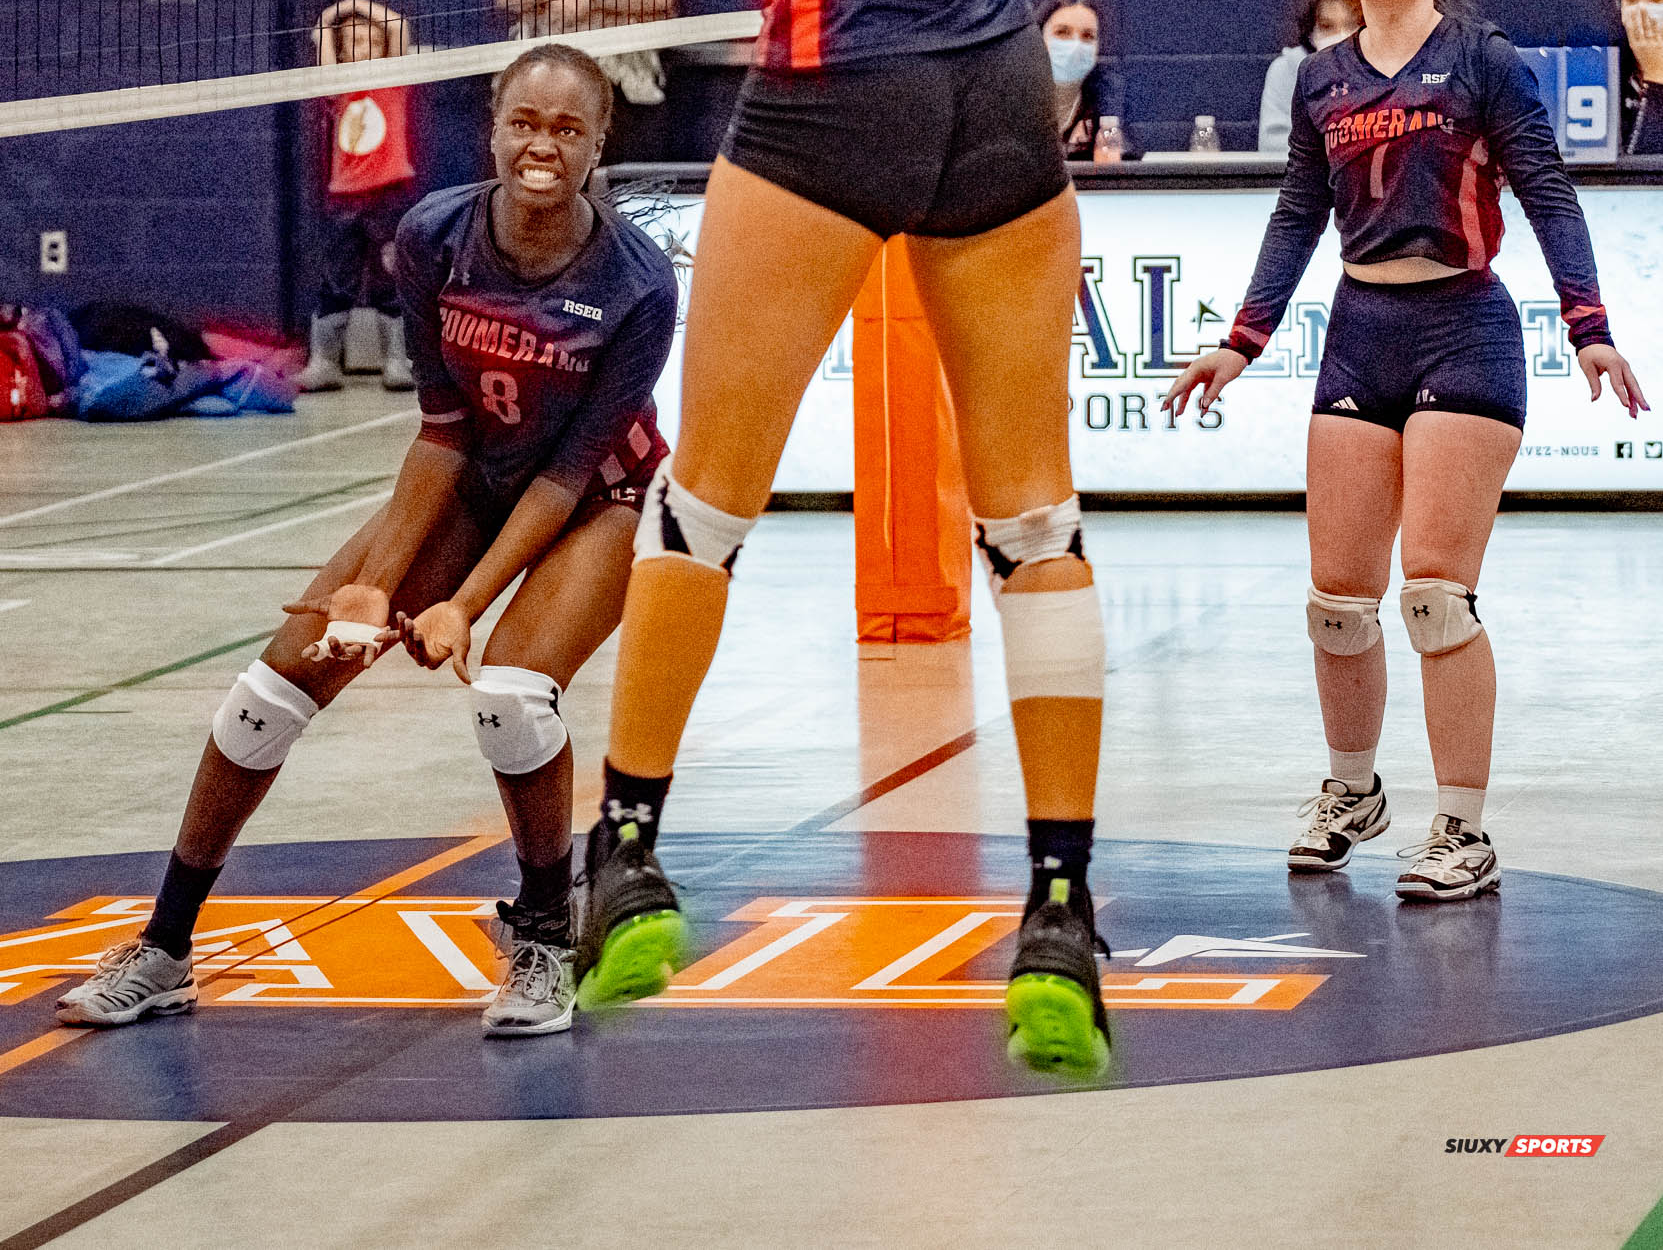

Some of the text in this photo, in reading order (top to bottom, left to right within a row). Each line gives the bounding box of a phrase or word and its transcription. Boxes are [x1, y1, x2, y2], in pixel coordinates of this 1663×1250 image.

[1566, 85, 1608, 141] 9
[1370, 142, 1390, 199] 1
[563, 299, 603, 321] RSEQ
[480, 370, 521, 425] 8
[1068, 394, 1224, 430] ORTS
